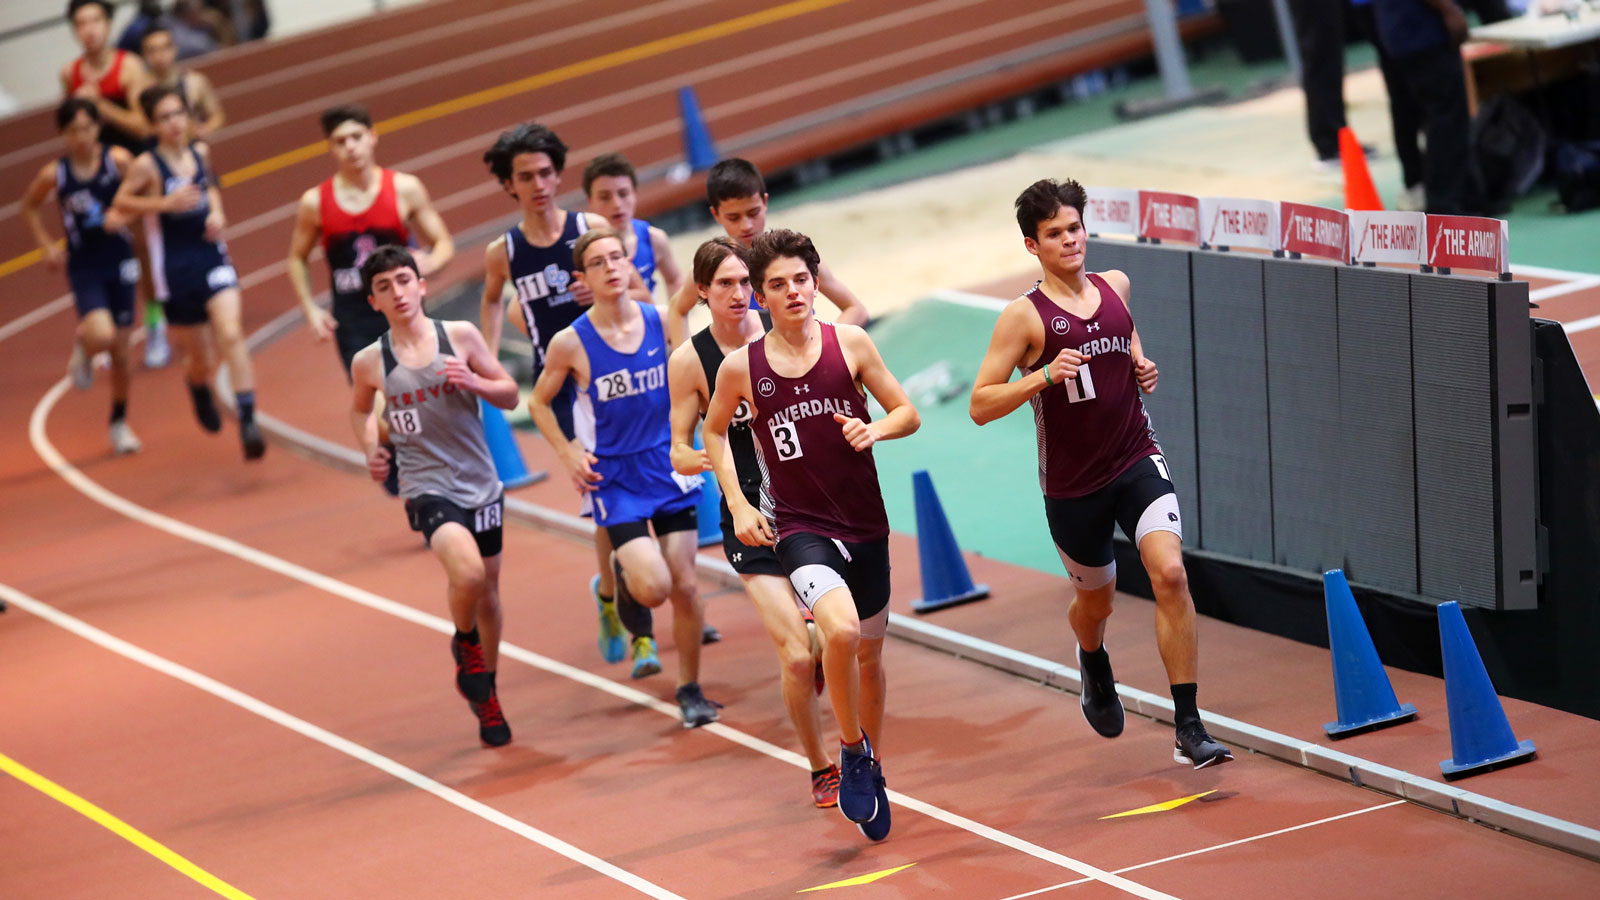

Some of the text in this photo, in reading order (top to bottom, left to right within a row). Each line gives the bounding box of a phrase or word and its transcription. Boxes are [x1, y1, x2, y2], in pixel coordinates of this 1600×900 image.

[1222, 210, 1241, 234] THE
[1295, 216, 1313, 243] THE
[1370, 223, 1417, 251] THE ARMORY
[1444, 228, 1496, 259] THE ARMORY
[1078, 336, 1131, 357] VERDALE
[389, 382, 465, 409] TREVO
[602, 373, 627, 398] 28
[393, 411, 417, 433] 18
[774, 427, 797, 458] 3
[477, 507, 498, 530] 18
